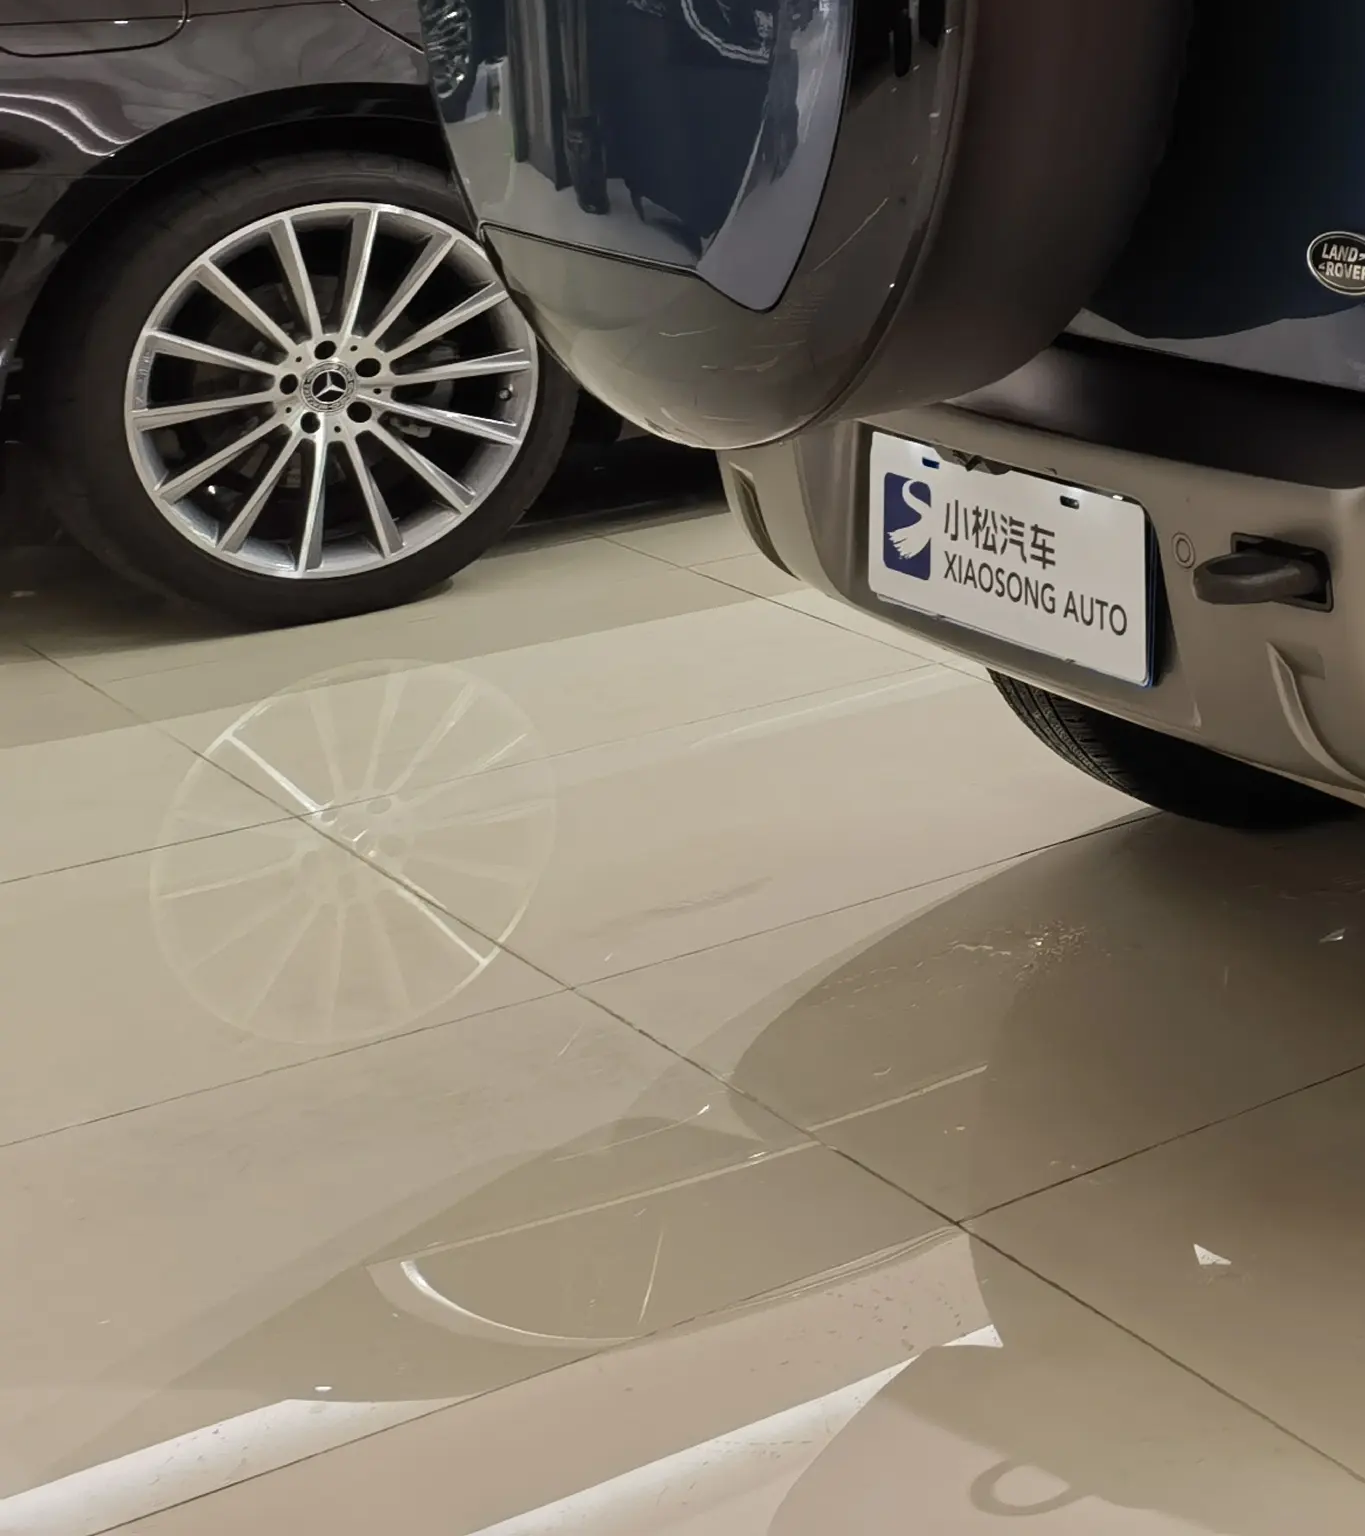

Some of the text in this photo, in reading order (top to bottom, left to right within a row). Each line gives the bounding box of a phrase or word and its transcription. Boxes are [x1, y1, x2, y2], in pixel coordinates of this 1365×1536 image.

[1321, 243, 1359, 262] LAND
[943, 499, 1057, 570] 小松汽车
[943, 550, 1128, 637] XIAOSONG AUTO
